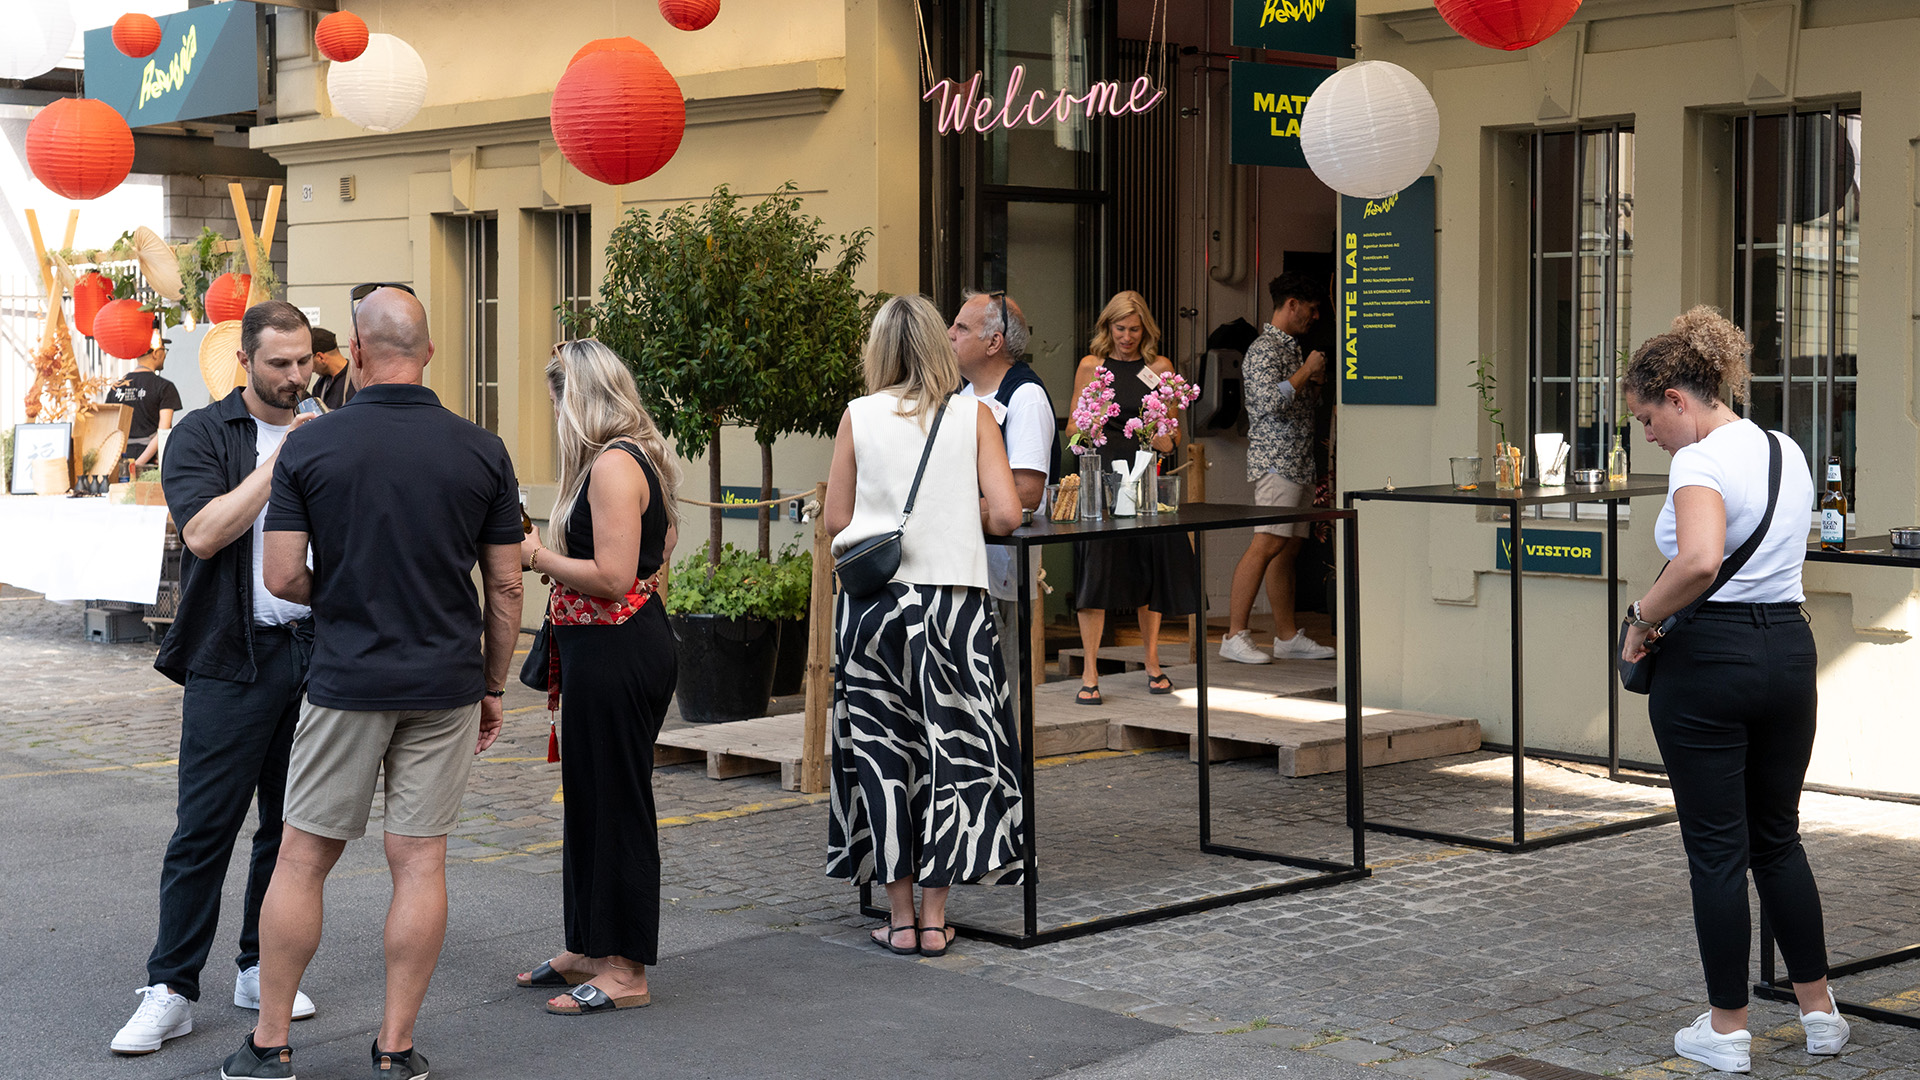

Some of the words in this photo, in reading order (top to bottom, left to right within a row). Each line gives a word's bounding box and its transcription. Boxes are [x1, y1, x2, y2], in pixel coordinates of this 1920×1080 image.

[922, 64, 1165, 134] Welcome
[1253, 92, 1311, 115] MAT
[1270, 117, 1301, 138] LA
[303, 187, 312, 200] 31
[1345, 232, 1358, 285] LAB
[1345, 290, 1358, 380] MATTE
[1525, 544, 1592, 559] VISITOR
